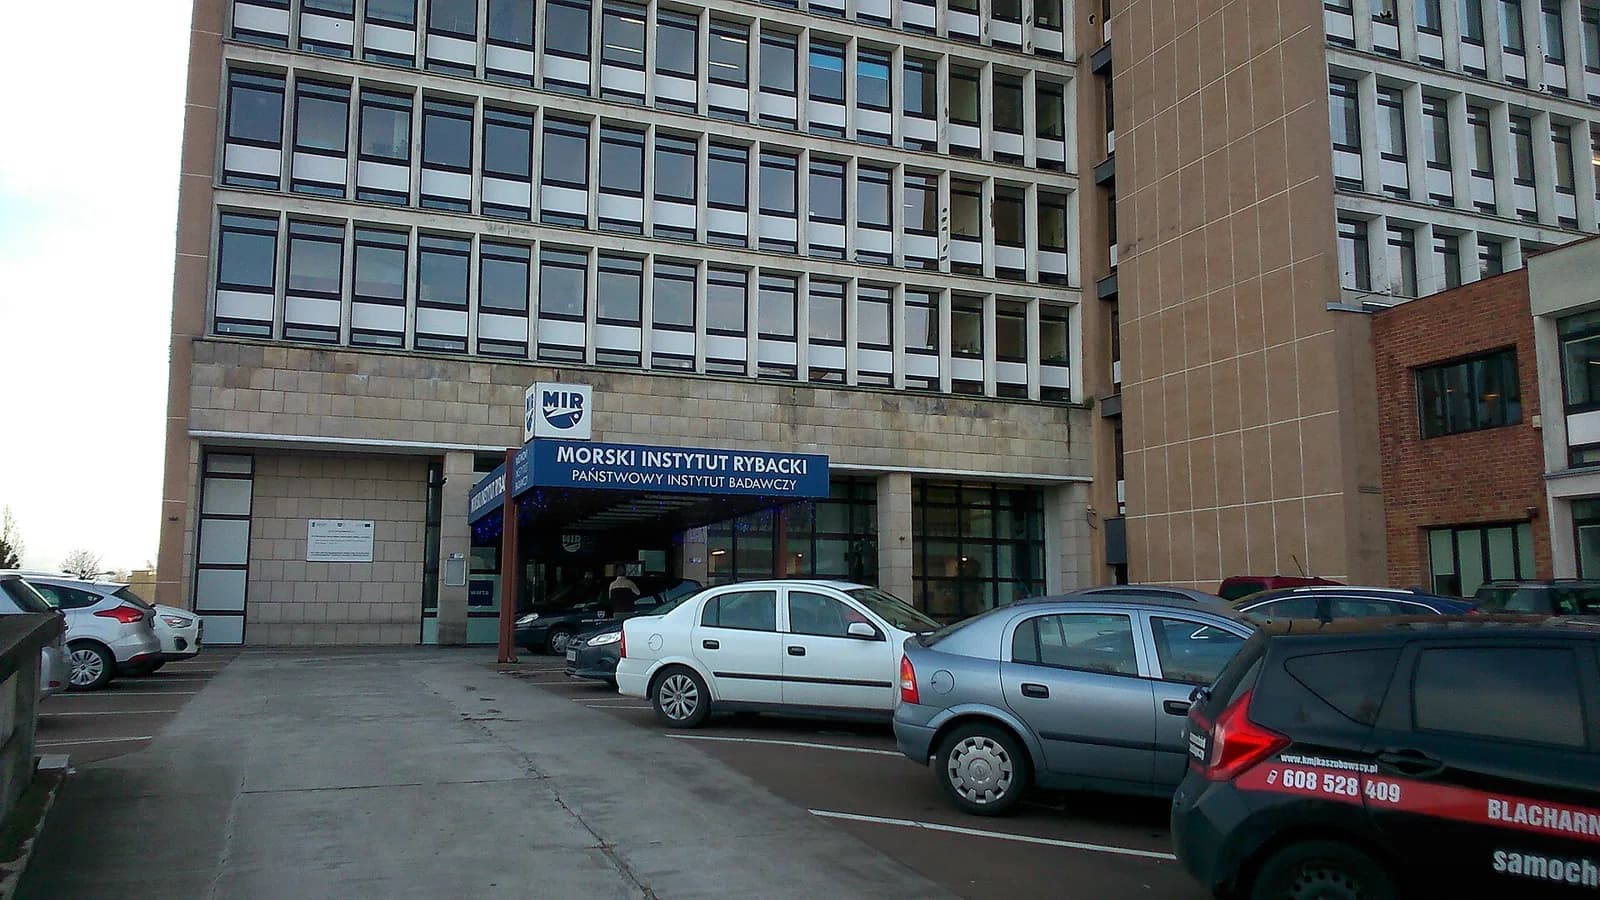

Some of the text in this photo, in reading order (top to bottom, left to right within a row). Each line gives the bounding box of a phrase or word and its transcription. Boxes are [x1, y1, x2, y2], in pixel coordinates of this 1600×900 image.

[543, 391, 584, 409] MIR
[557, 446, 808, 475] MORSKI INSTYTUT RYBACKI
[572, 467, 798, 491] PAŃSTWOWY INSTYTUT BADAWCZY
[1283, 769, 1400, 802] 608 528 409
